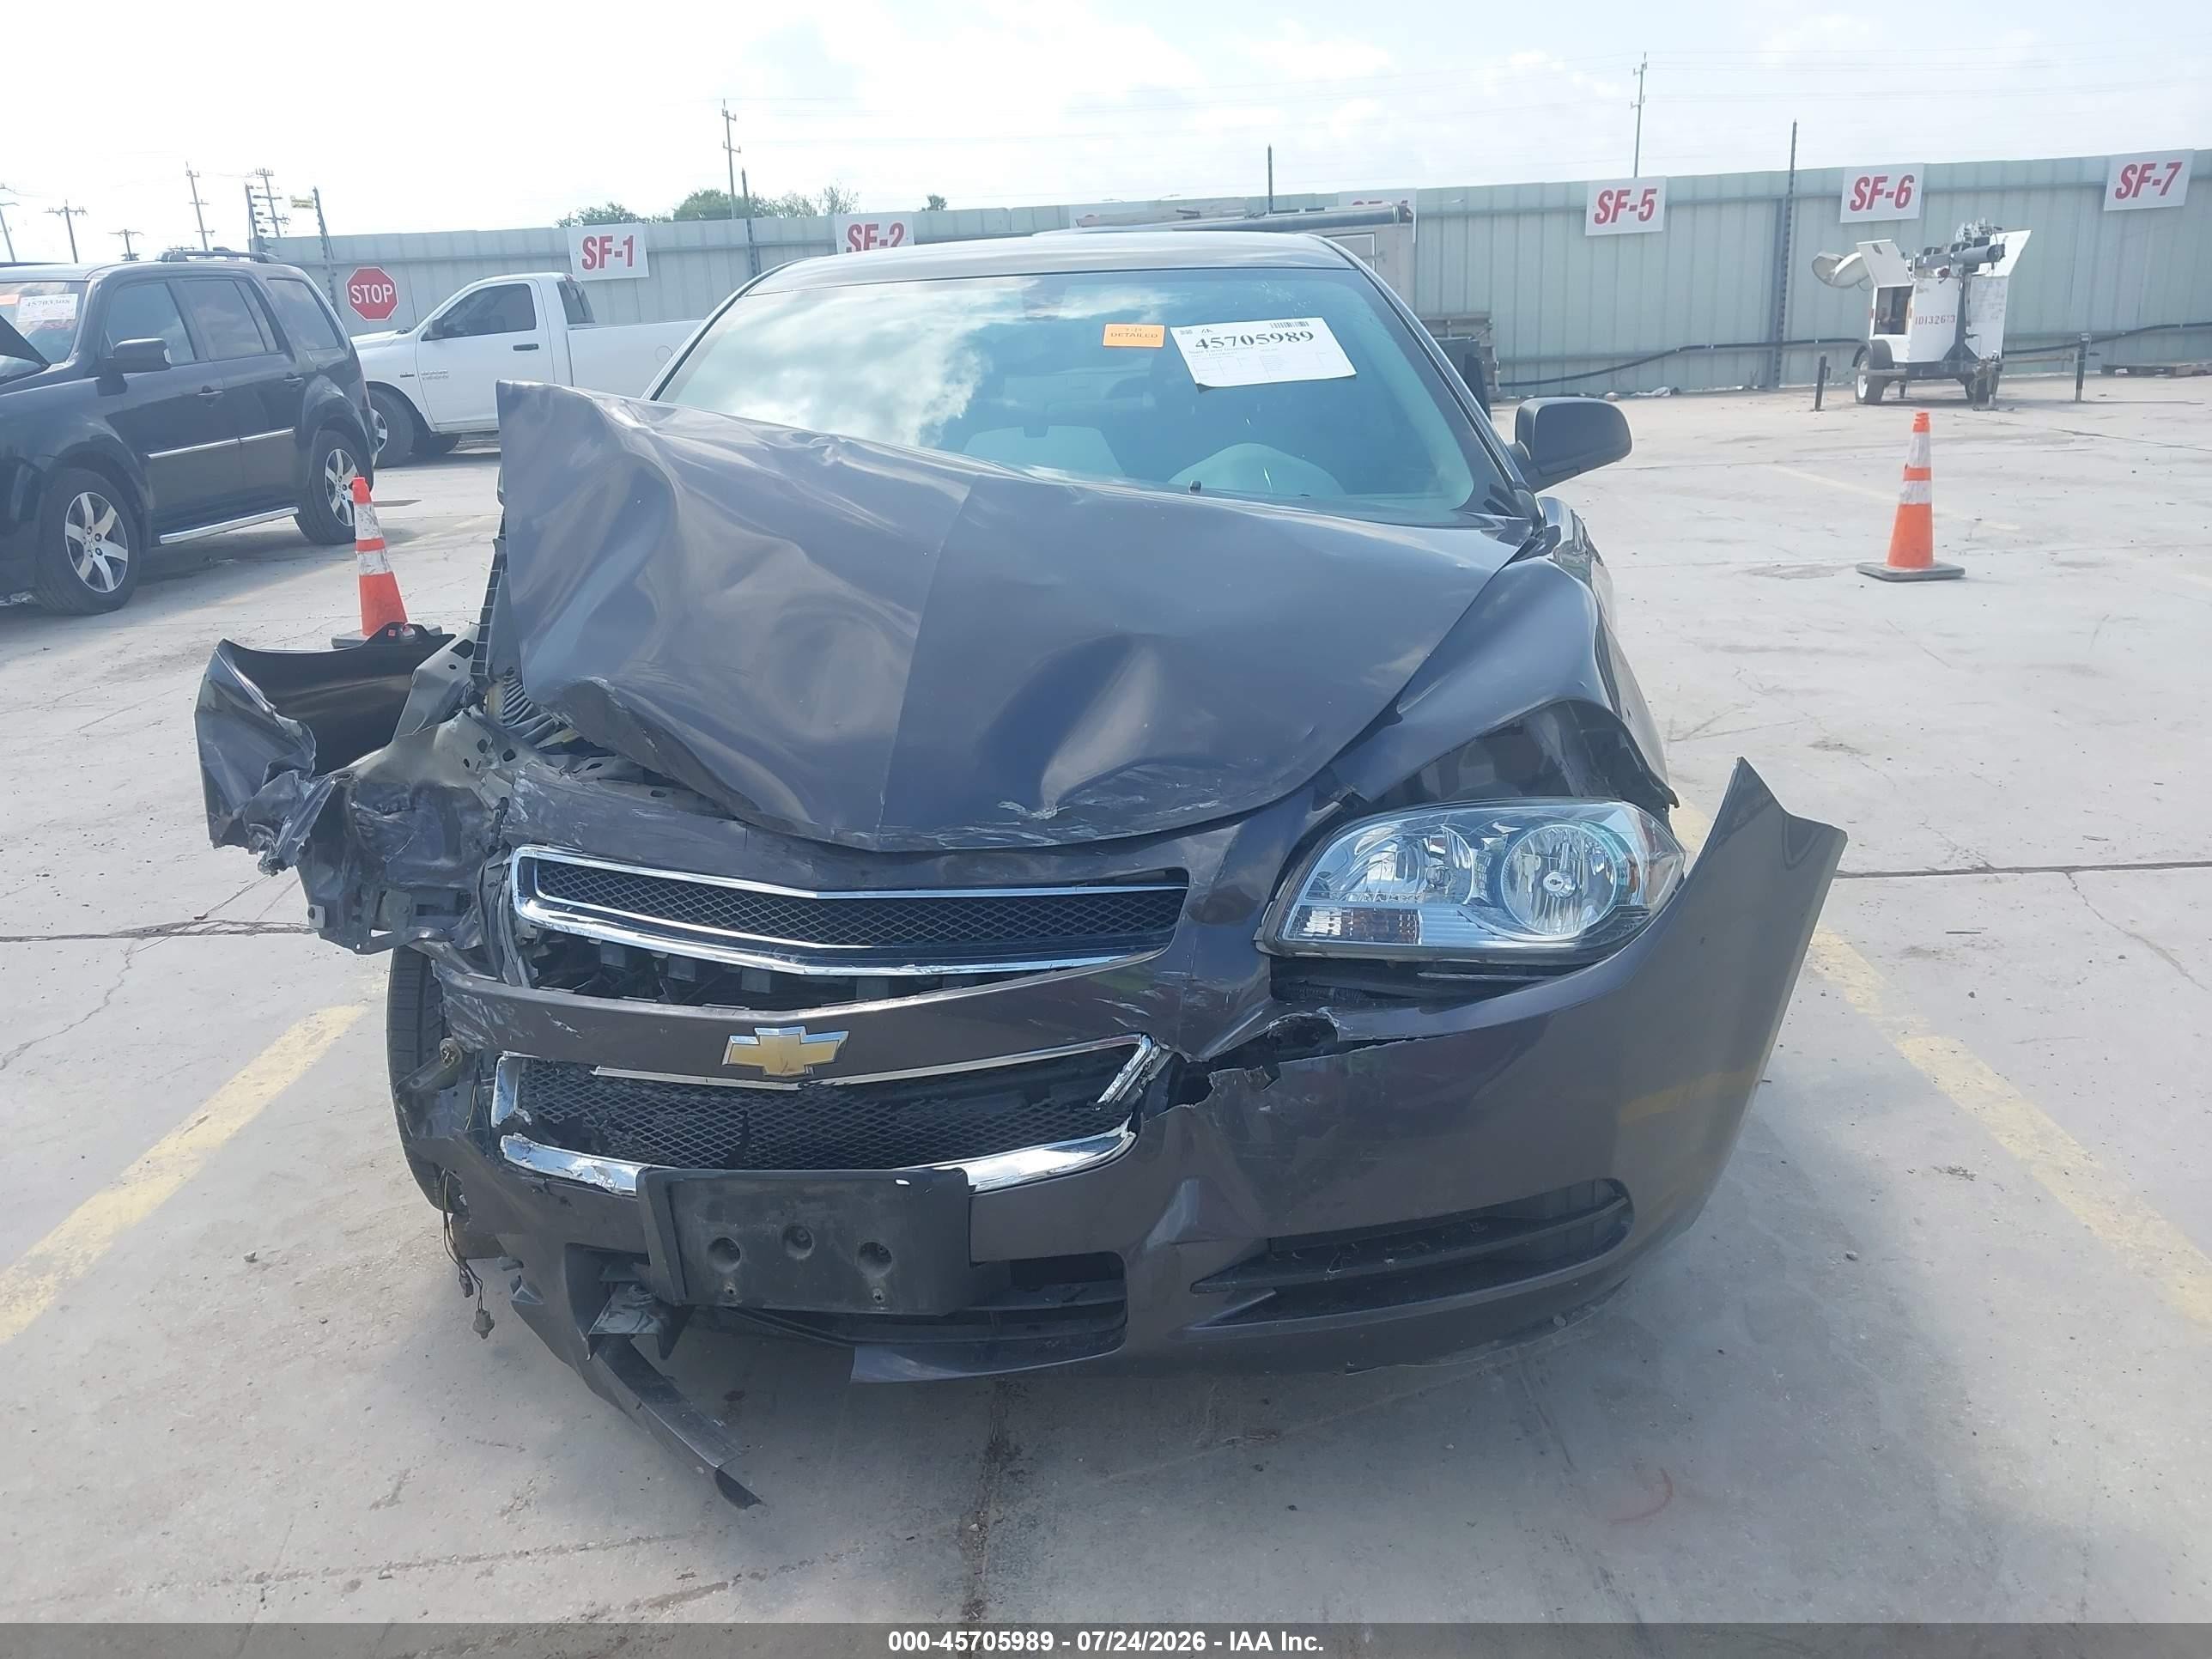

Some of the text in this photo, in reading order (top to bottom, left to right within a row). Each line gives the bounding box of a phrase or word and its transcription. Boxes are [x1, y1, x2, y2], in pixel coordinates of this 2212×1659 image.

[1849, 174, 1915, 212] SF-6
[2115, 161, 2183, 200] SF-7
[1594, 188, 1657, 225] SF-5
[581, 234, 634, 270] SF-1
[846, 222, 905, 253] SF-2
[350, 283, 393, 304] STOP
[1195, 331, 1315, 349] 45705989
